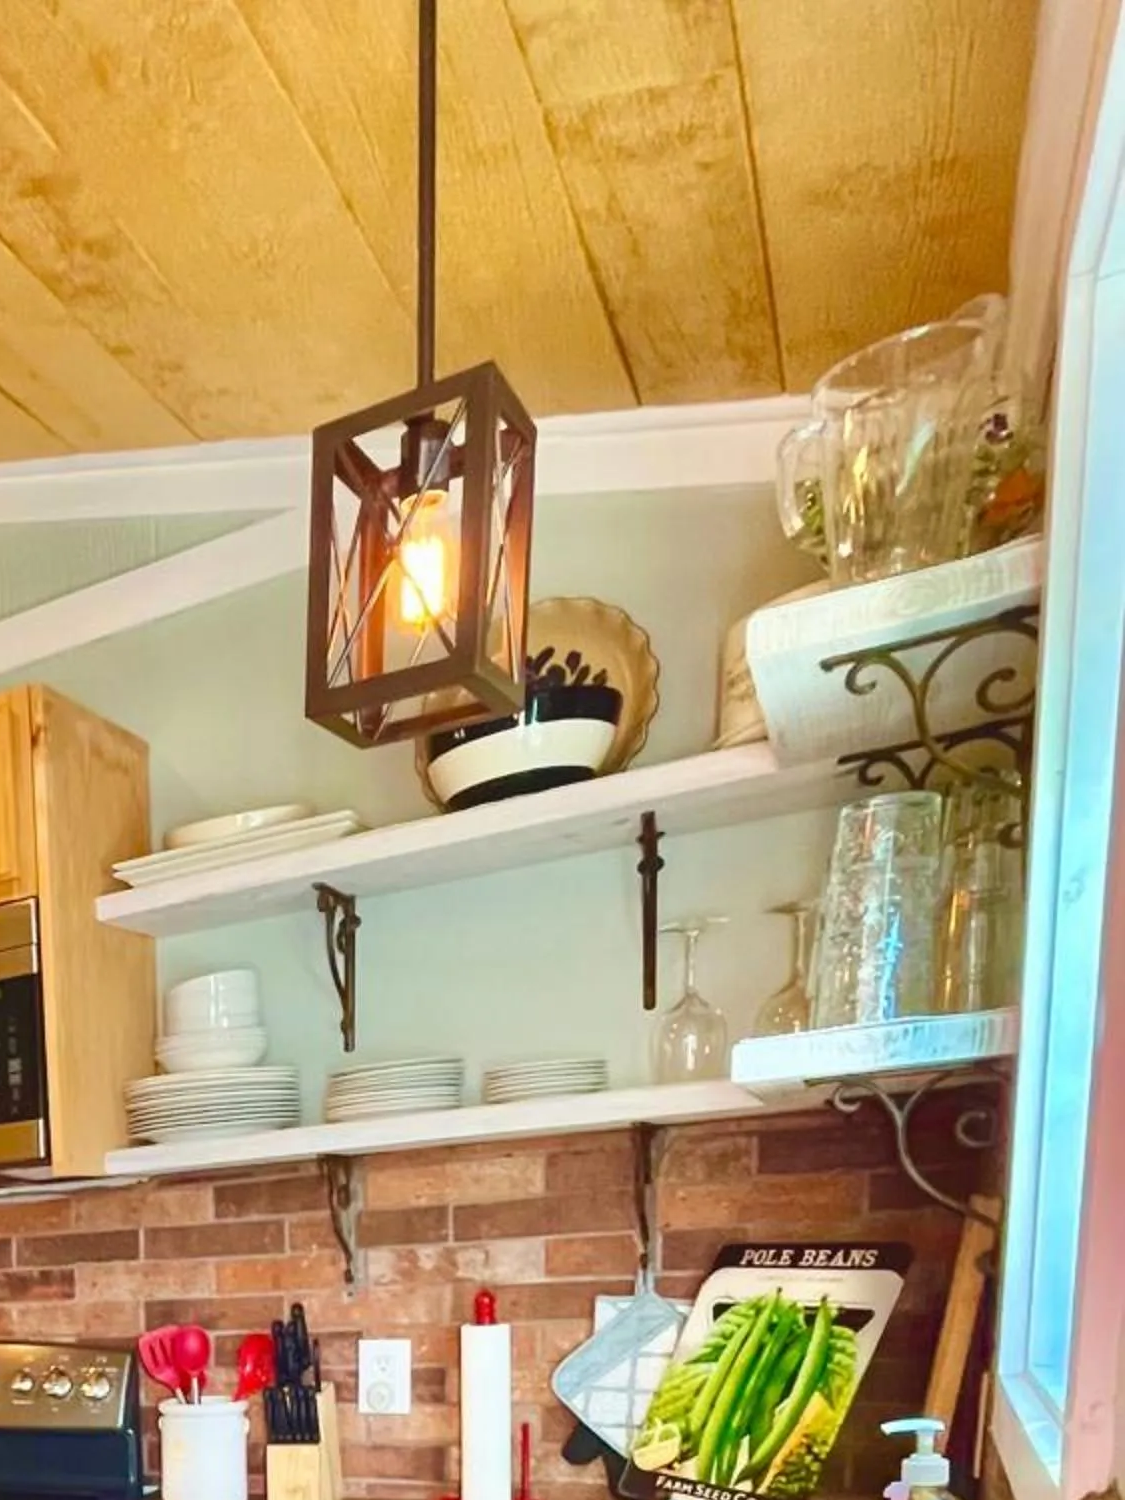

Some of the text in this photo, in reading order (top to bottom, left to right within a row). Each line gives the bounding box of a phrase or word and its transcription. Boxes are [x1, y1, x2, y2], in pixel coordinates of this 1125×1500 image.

[740, 1249, 878, 1267] POLE BEANS
[655, 1475, 693, 1495] FARM
